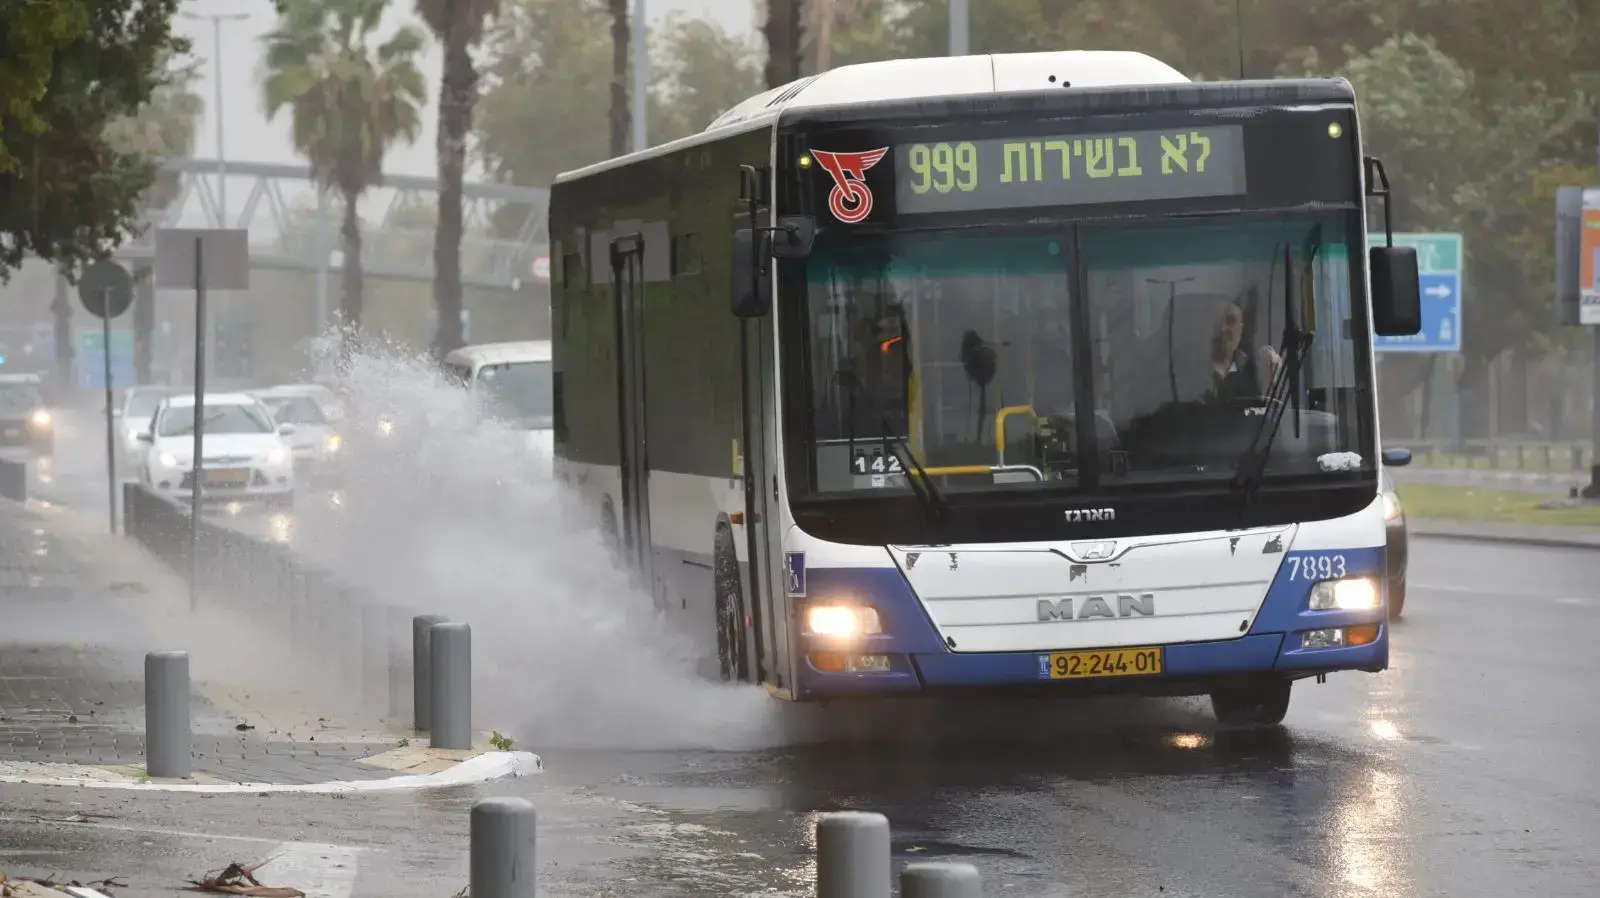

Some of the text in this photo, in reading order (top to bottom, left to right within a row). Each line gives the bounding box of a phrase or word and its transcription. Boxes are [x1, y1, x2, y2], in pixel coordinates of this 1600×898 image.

[909, 131, 1211, 194] לא בשירות 999
[855, 455, 902, 473] 142
[1064, 508, 1116, 523] הארגז
[1287, 554, 1347, 581] 7893
[1037, 592, 1155, 621] MAN
